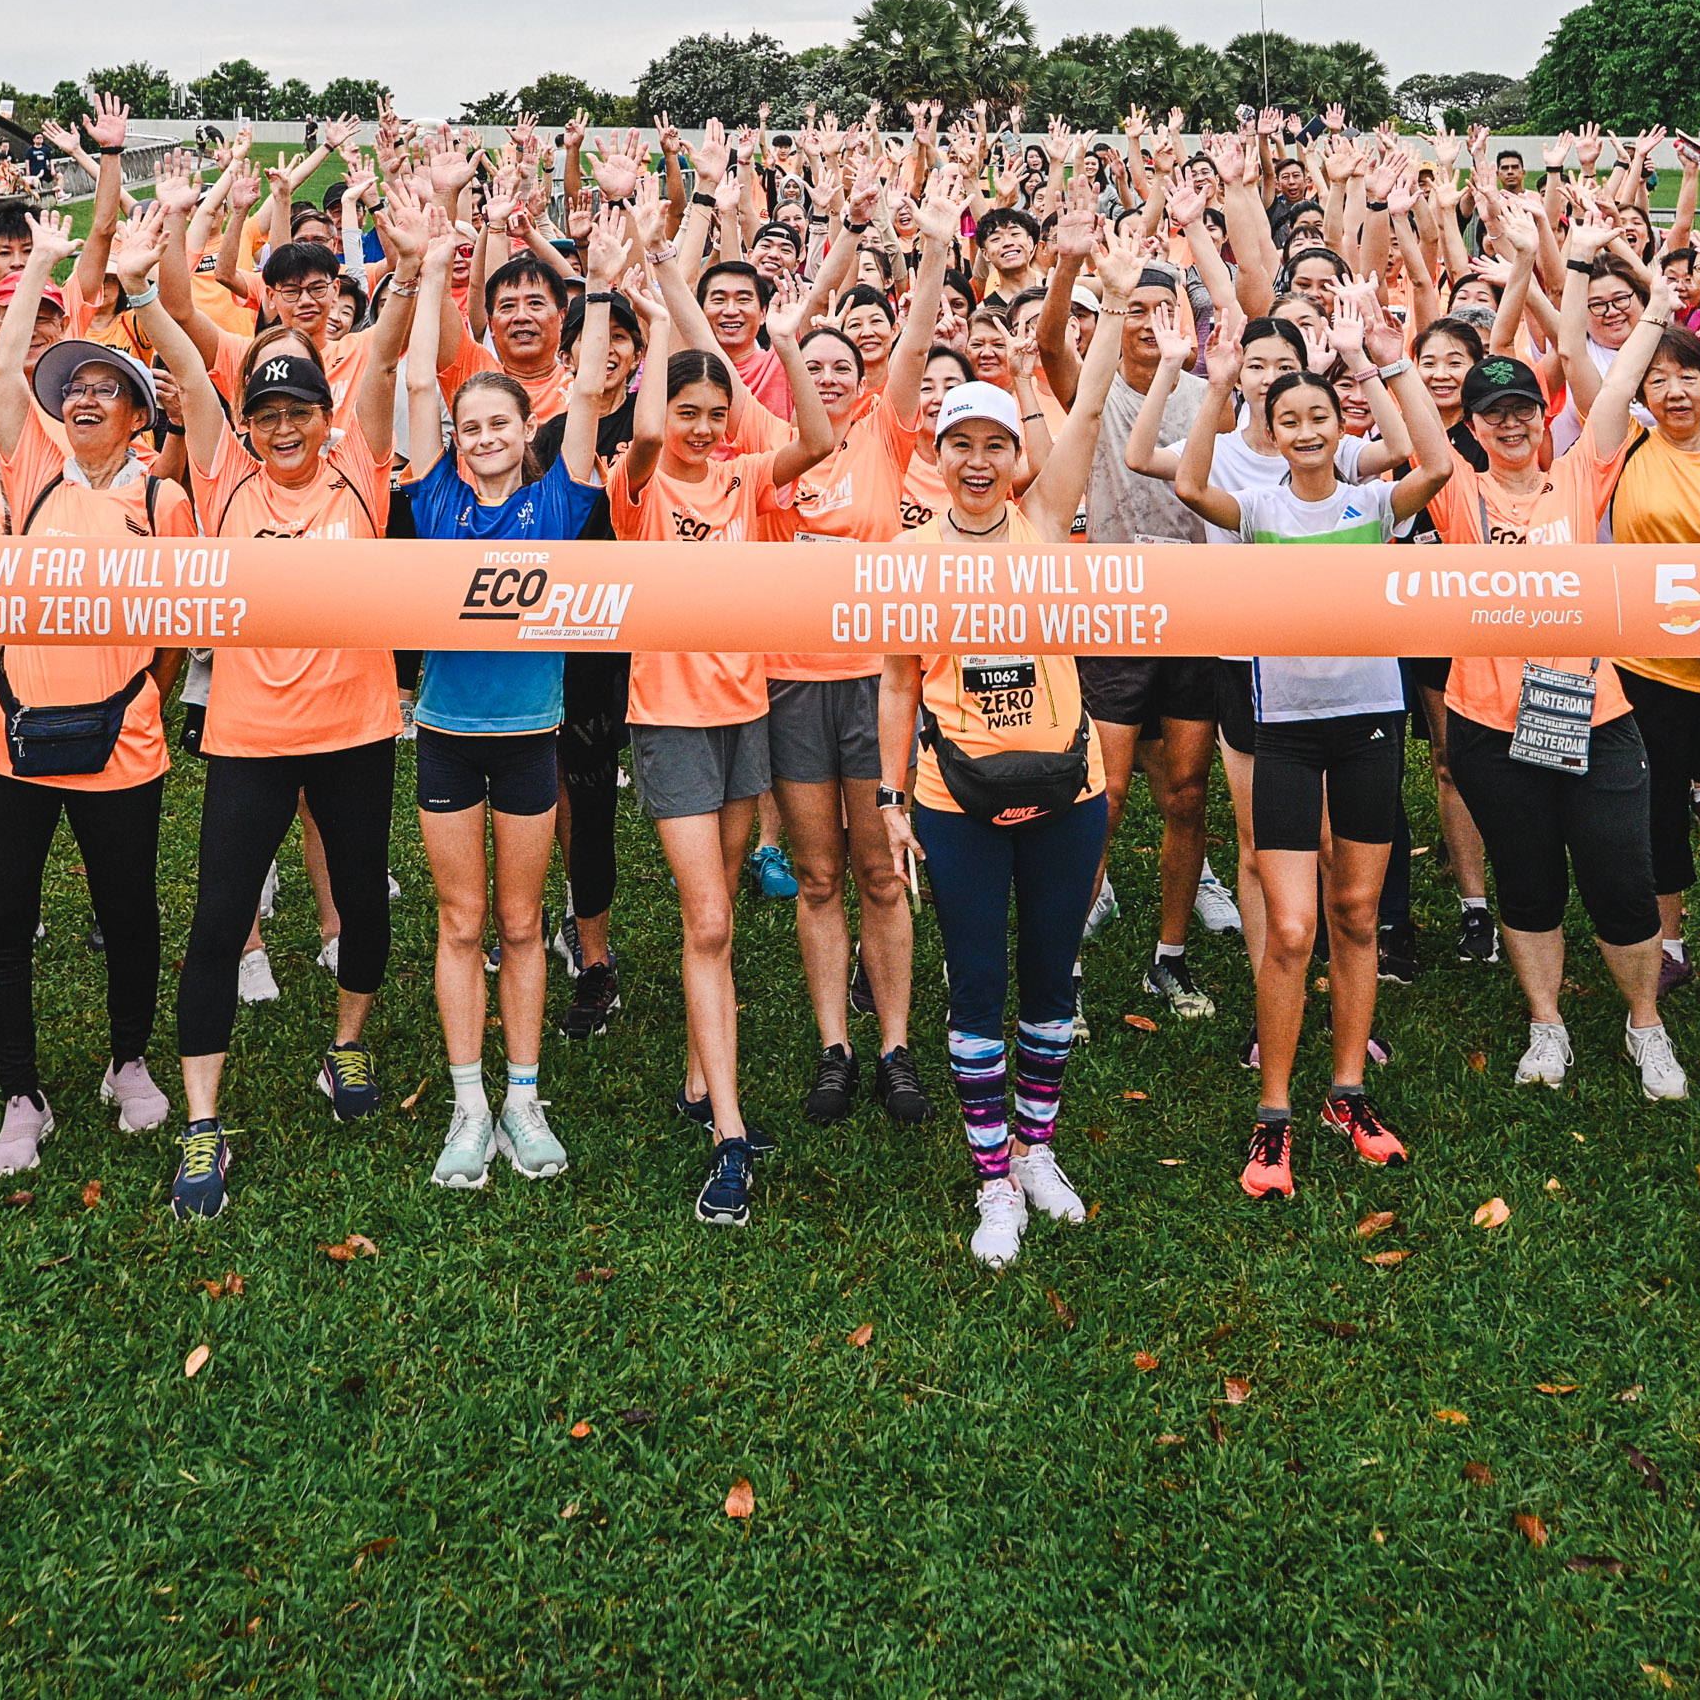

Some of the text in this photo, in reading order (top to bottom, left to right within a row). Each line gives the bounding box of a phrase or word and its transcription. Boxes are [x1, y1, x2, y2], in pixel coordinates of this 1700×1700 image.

[28, 548, 86, 587] FAR
[98, 548, 163, 588] WILL
[173, 548, 231, 588] YOU
[484, 551, 550, 564] income
[854, 554, 1144, 594] HOW FAR WILL YOU
[1430, 570, 1581, 598] income
[463, 568, 634, 627] ECO RUN
[37, 596, 112, 635] ZERO
[122, 597, 247, 637] WASTE?
[832, 602, 1168, 644] GO FOR ZERO WASTE?
[1470, 604, 1583, 629] made yours
[530, 628, 606, 637] TOWARDS ZERO WASTE
[980, 670, 1019, 684] 11062
[980, 689, 1034, 715] ZERO
[1529, 688, 1592, 715] AMSTERDAM
[988, 711, 1032, 730] WASTE
[1518, 728, 1587, 754] AMSTERDAM
[1000, 805, 1039, 819] NIKE
